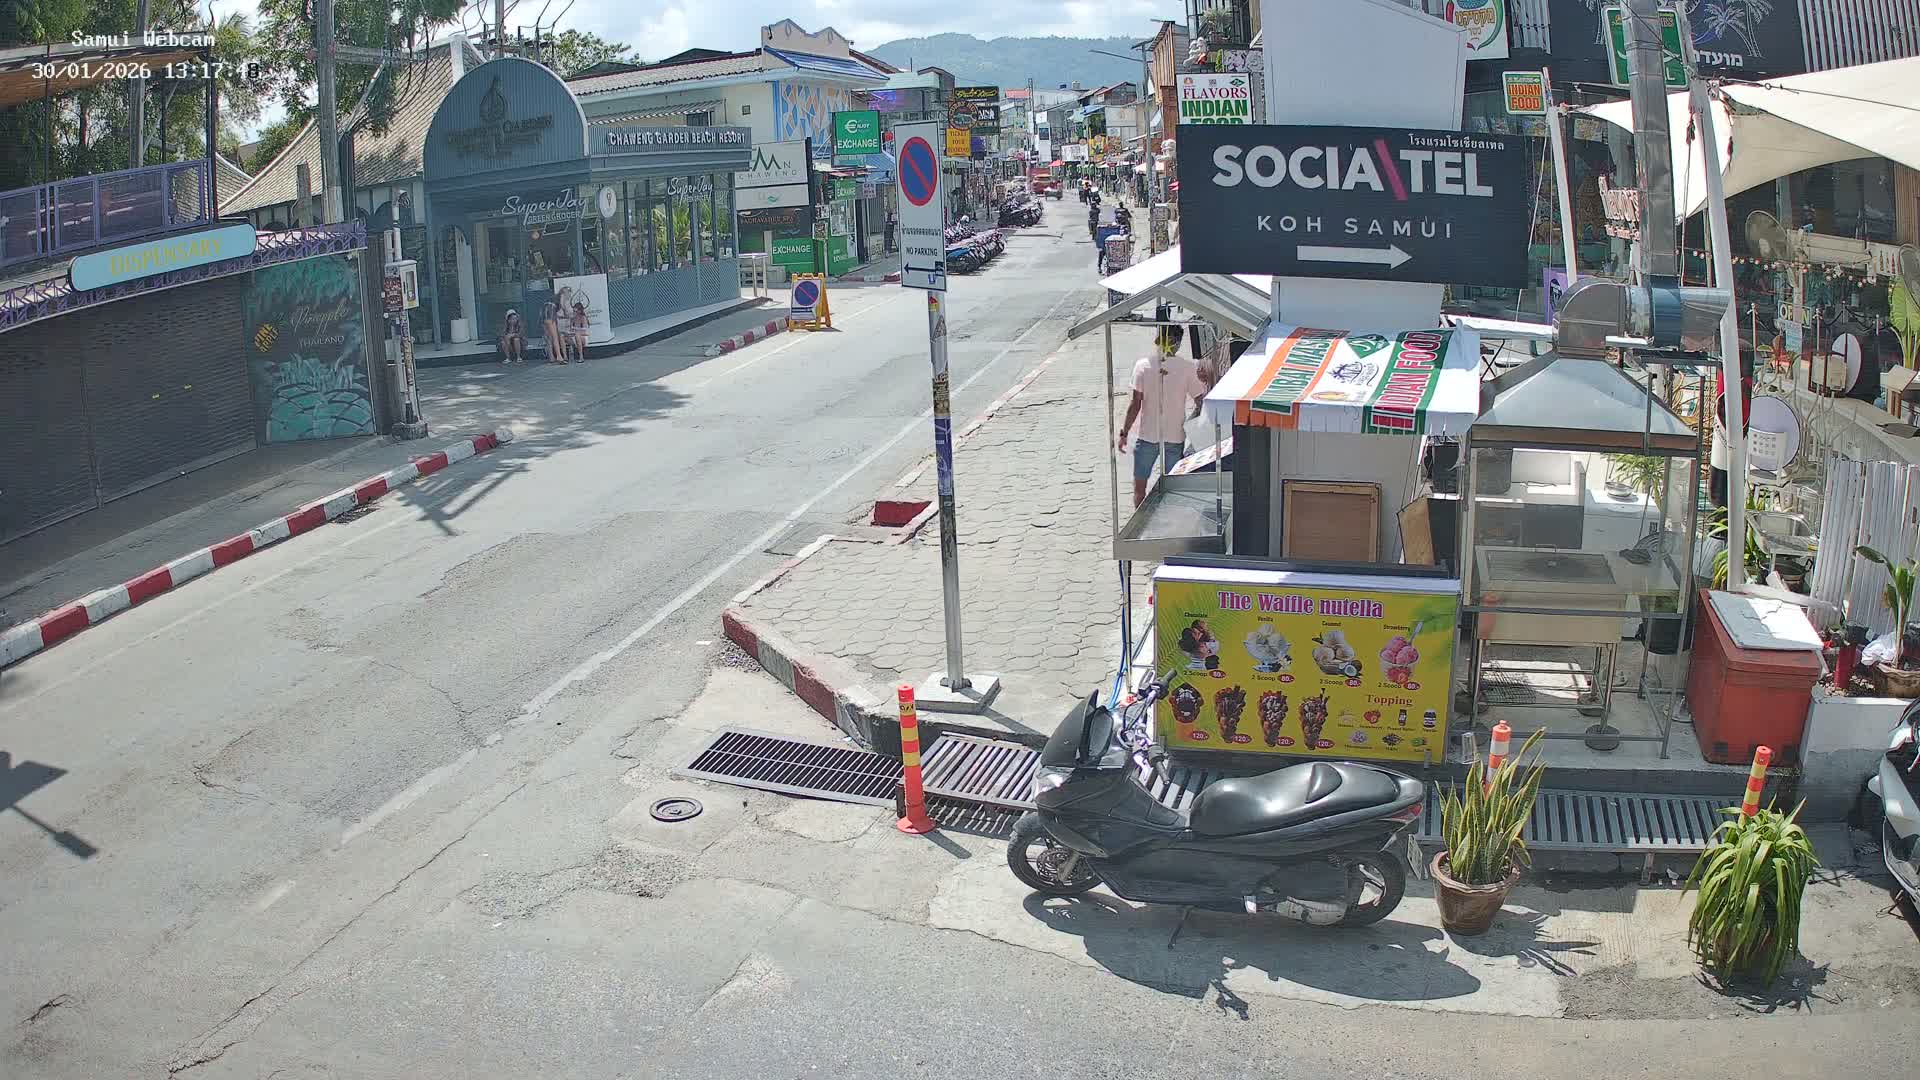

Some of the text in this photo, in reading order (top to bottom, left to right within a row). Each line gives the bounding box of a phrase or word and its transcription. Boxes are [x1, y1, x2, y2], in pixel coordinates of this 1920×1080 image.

[1183, 87, 1248, 99] FLAVORS
[1508, 84, 1541, 96] INDIAN
[1182, 100, 1249, 117] INDIAN
[1511, 97, 1540, 109] FOOD
[609, 131, 746, 146] CHAWENG GARDEN BEACH RESORT
[837, 139, 878, 149] EXCHANGE
[1257, 215, 1452, 238] KOH SAMUI
[772, 245, 812, 255] EXCHANGE
[905, 246, 938, 257] NO PARKING
[110, 239, 222, 277] DISPENSARY
[1780, 303, 1810, 327] OPN
[1370, 331, 1443, 431] INDIAN FOOD
[1217, 590, 1384, 619] The Waffle nutella
[1366, 694, 1413, 706] Topping
